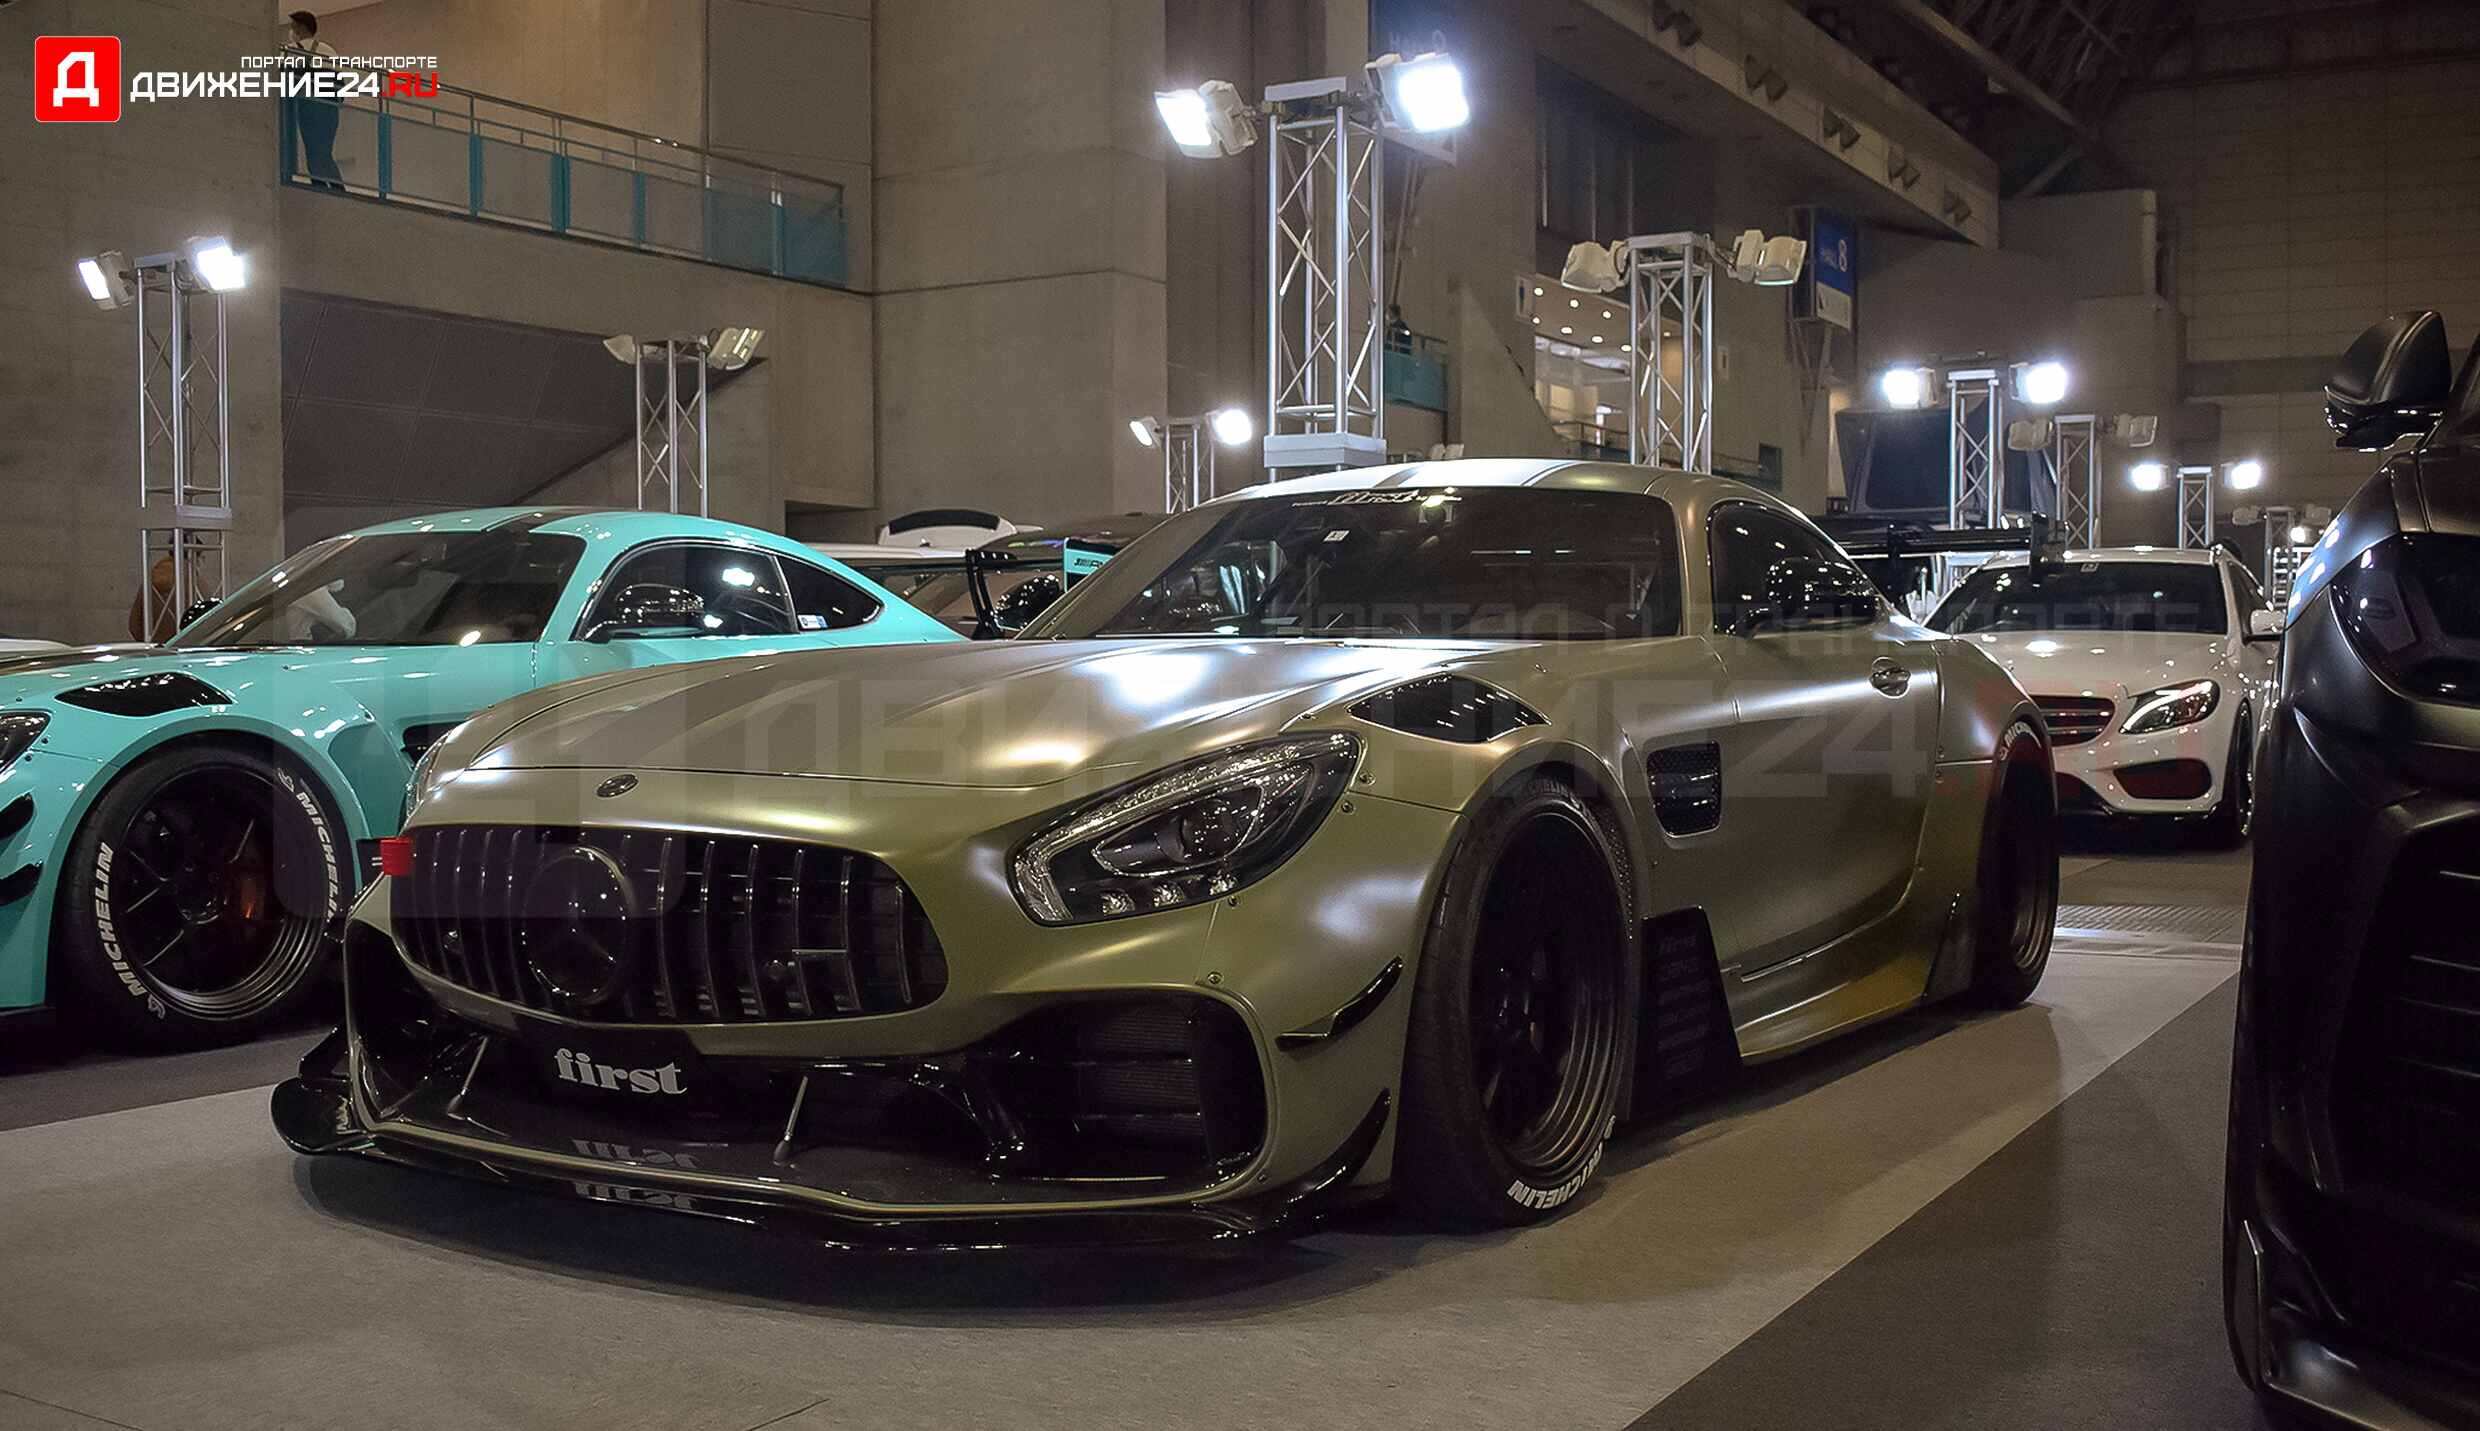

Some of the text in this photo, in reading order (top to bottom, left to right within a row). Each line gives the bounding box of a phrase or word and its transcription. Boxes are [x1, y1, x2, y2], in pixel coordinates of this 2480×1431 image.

[1838, 239, 1848, 273] 8
[94, 841, 148, 997] MICHELIN
[553, 1047, 688, 1095] first
